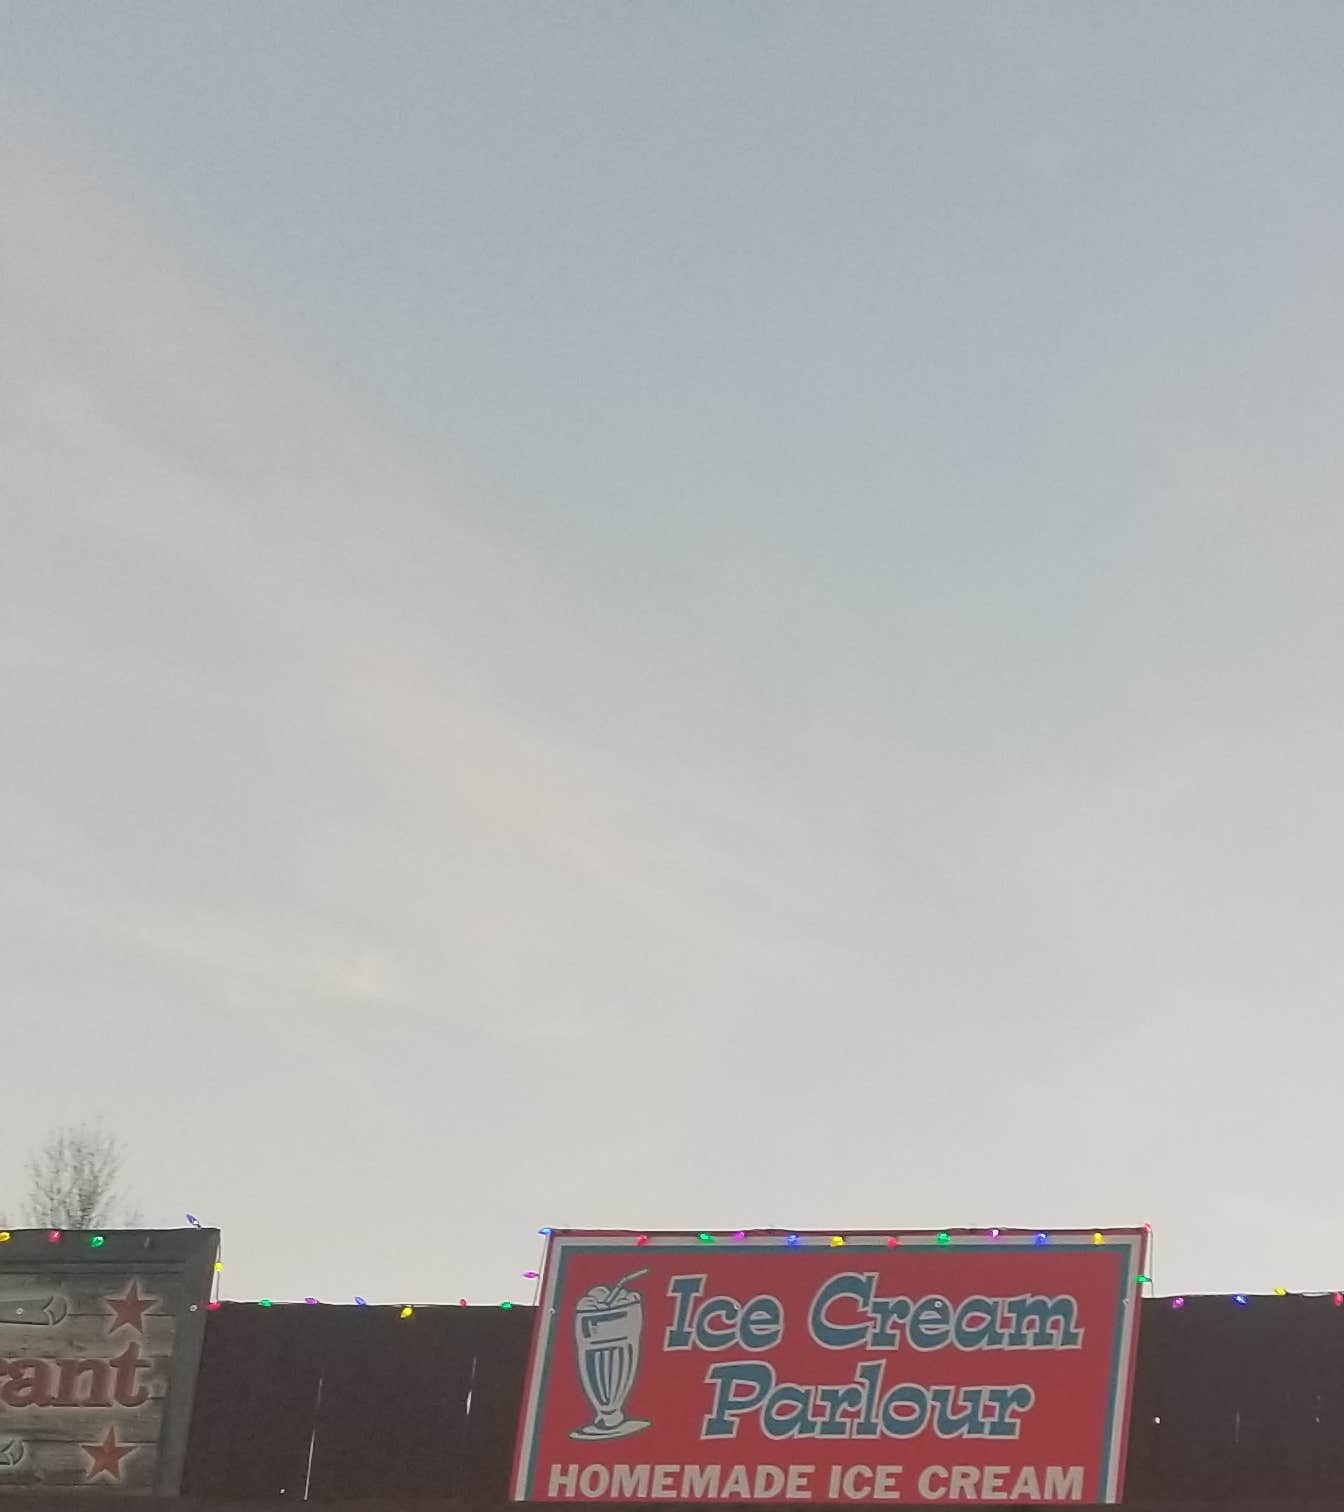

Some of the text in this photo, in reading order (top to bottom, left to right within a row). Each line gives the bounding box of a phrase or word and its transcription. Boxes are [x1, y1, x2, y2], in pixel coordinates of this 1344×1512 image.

[663, 1271, 1085, 1352] Ice Cream
[699, 1359, 1036, 1441] Parlour
[547, 1463, 1085, 1502] HOMEMADE ICE CREAM
